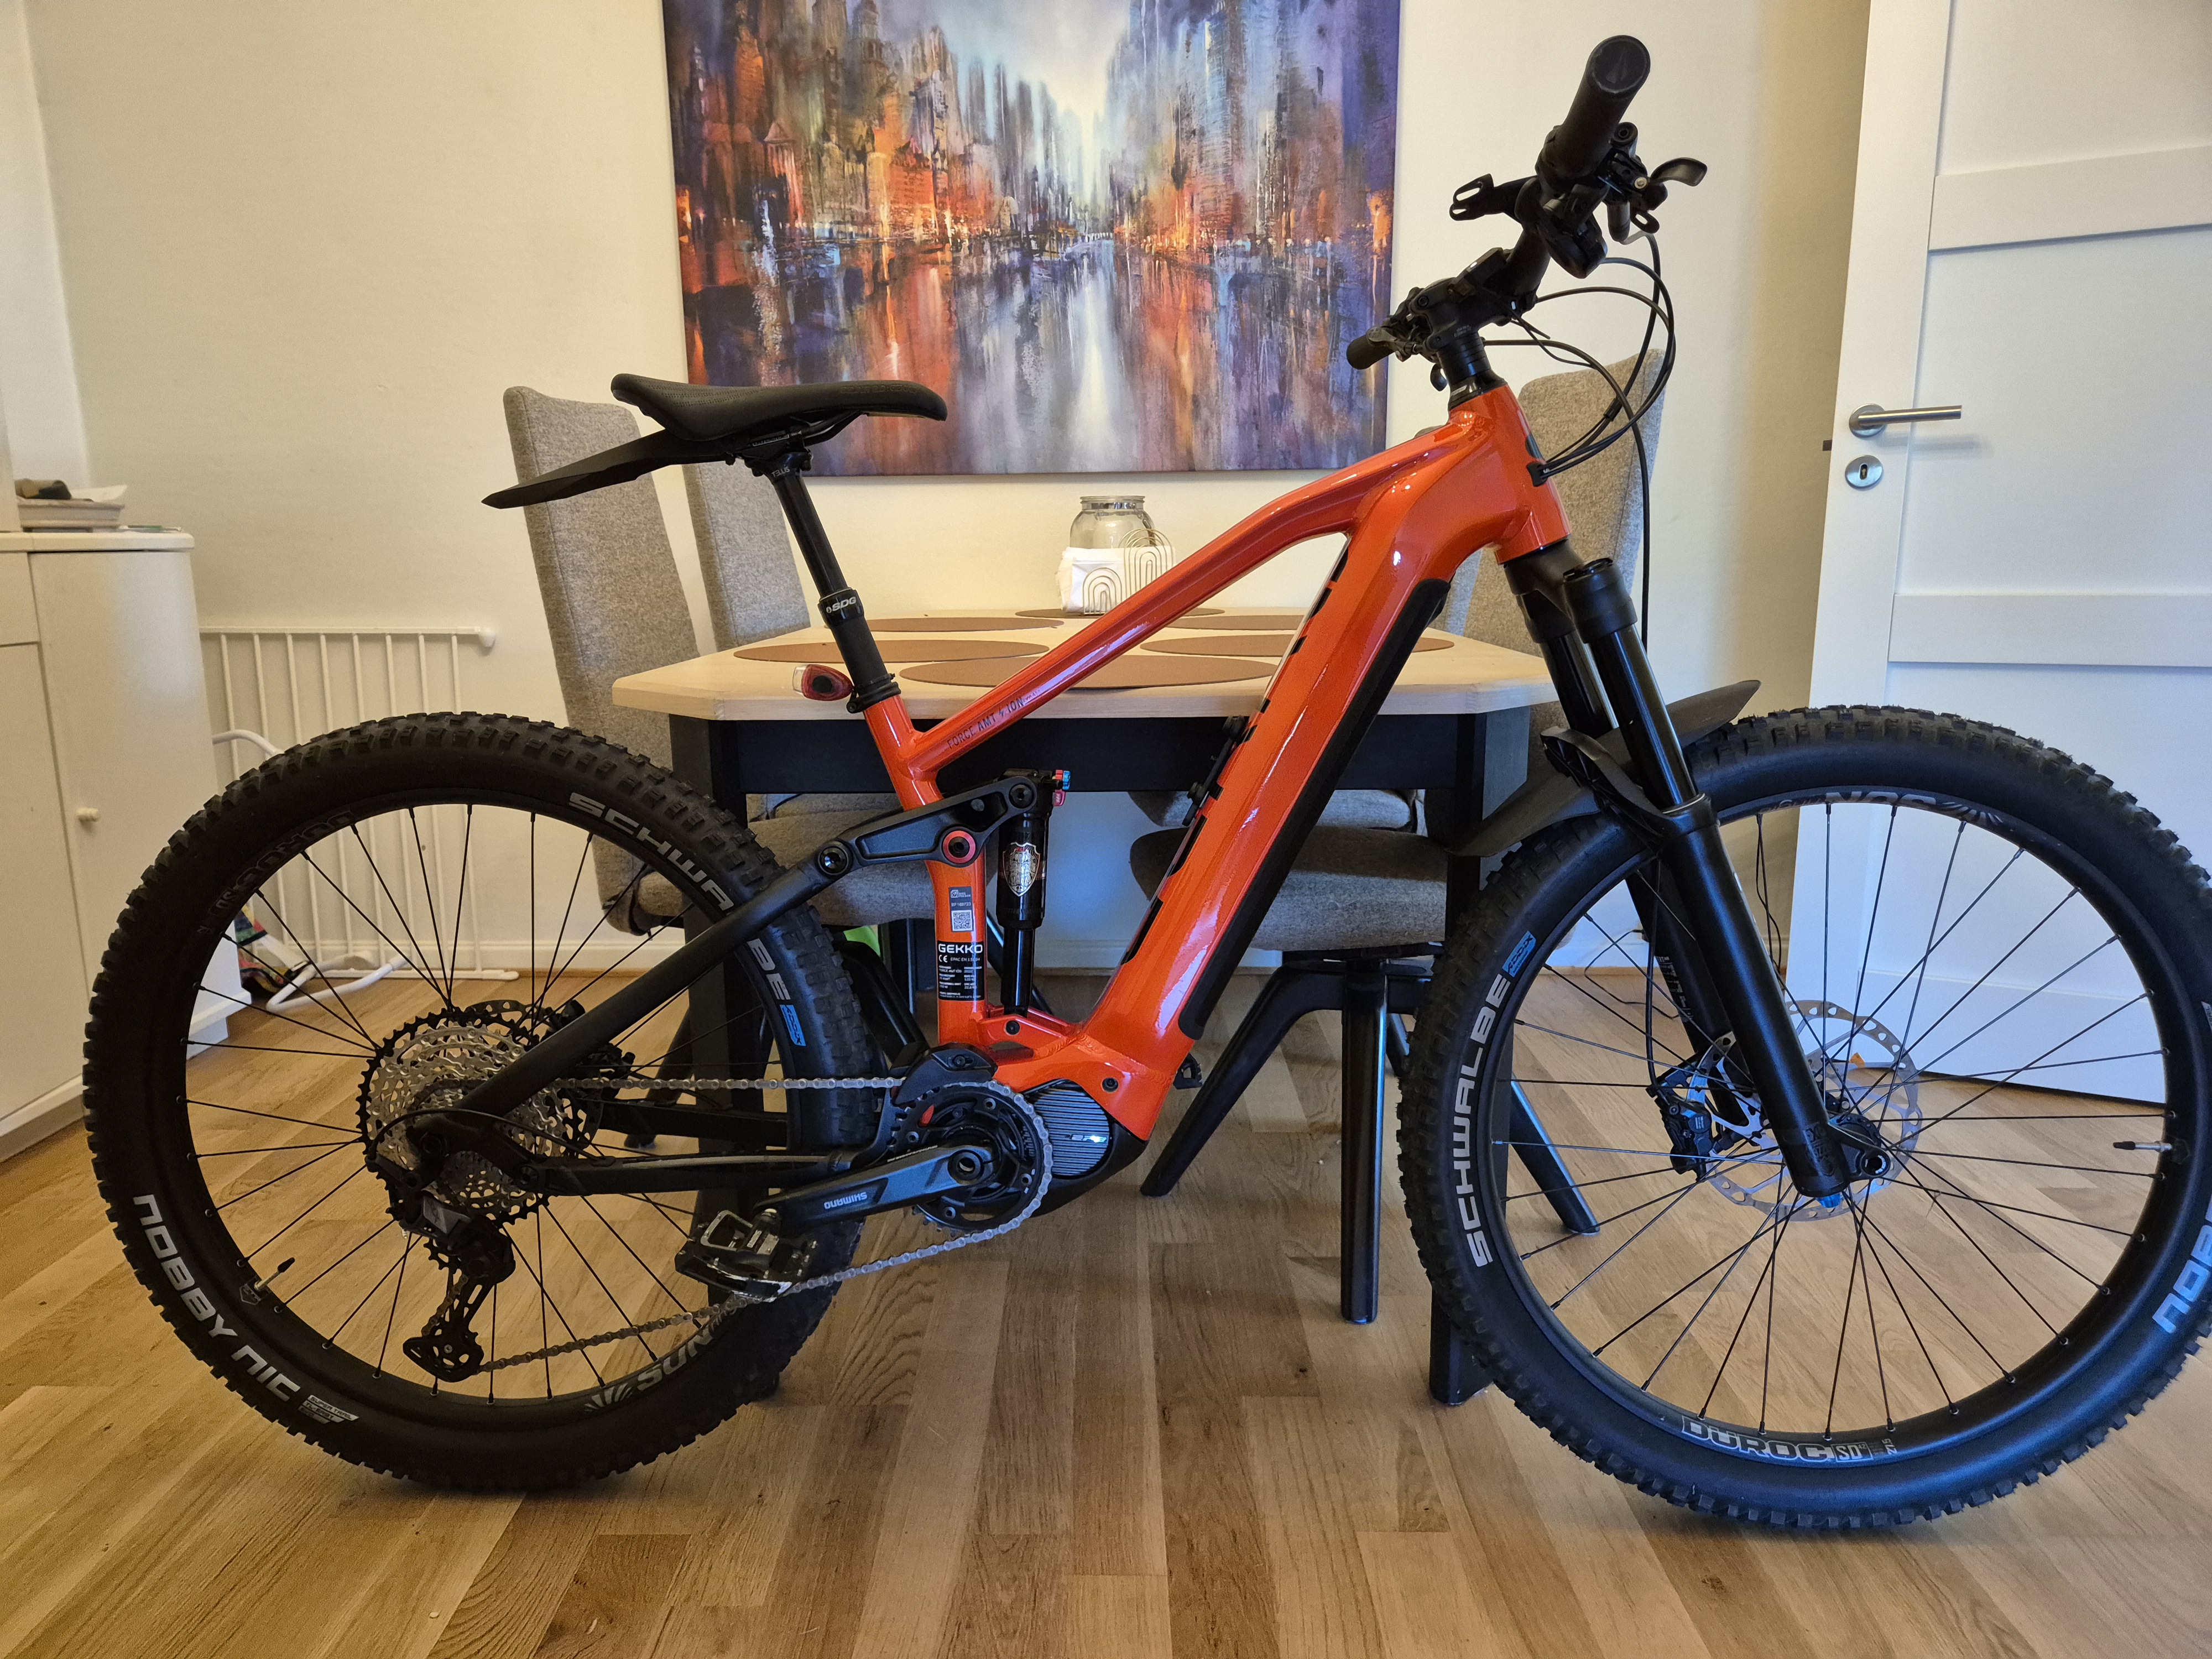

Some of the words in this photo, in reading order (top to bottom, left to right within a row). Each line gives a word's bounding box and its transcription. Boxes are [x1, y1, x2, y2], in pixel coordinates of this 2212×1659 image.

[832, 596, 857, 612] SDG
[947, 726, 977, 749] FORCE
[977, 712, 997, 732] AMT
[1005, 697, 1025, 714] ION
[569, 792, 791, 1000] SCHWABE
[938, 943, 983, 954] GEKKO
[1453, 973, 1511, 1267] SCHWALBE
[823, 1192, 868, 1209] SHIMANO
[132, 1194, 238, 1338] NOBBY
[231, 1344, 301, 1402] NIC
[637, 1325, 714, 1391] SUN
[1681, 1415, 1830, 1462] DUROC
